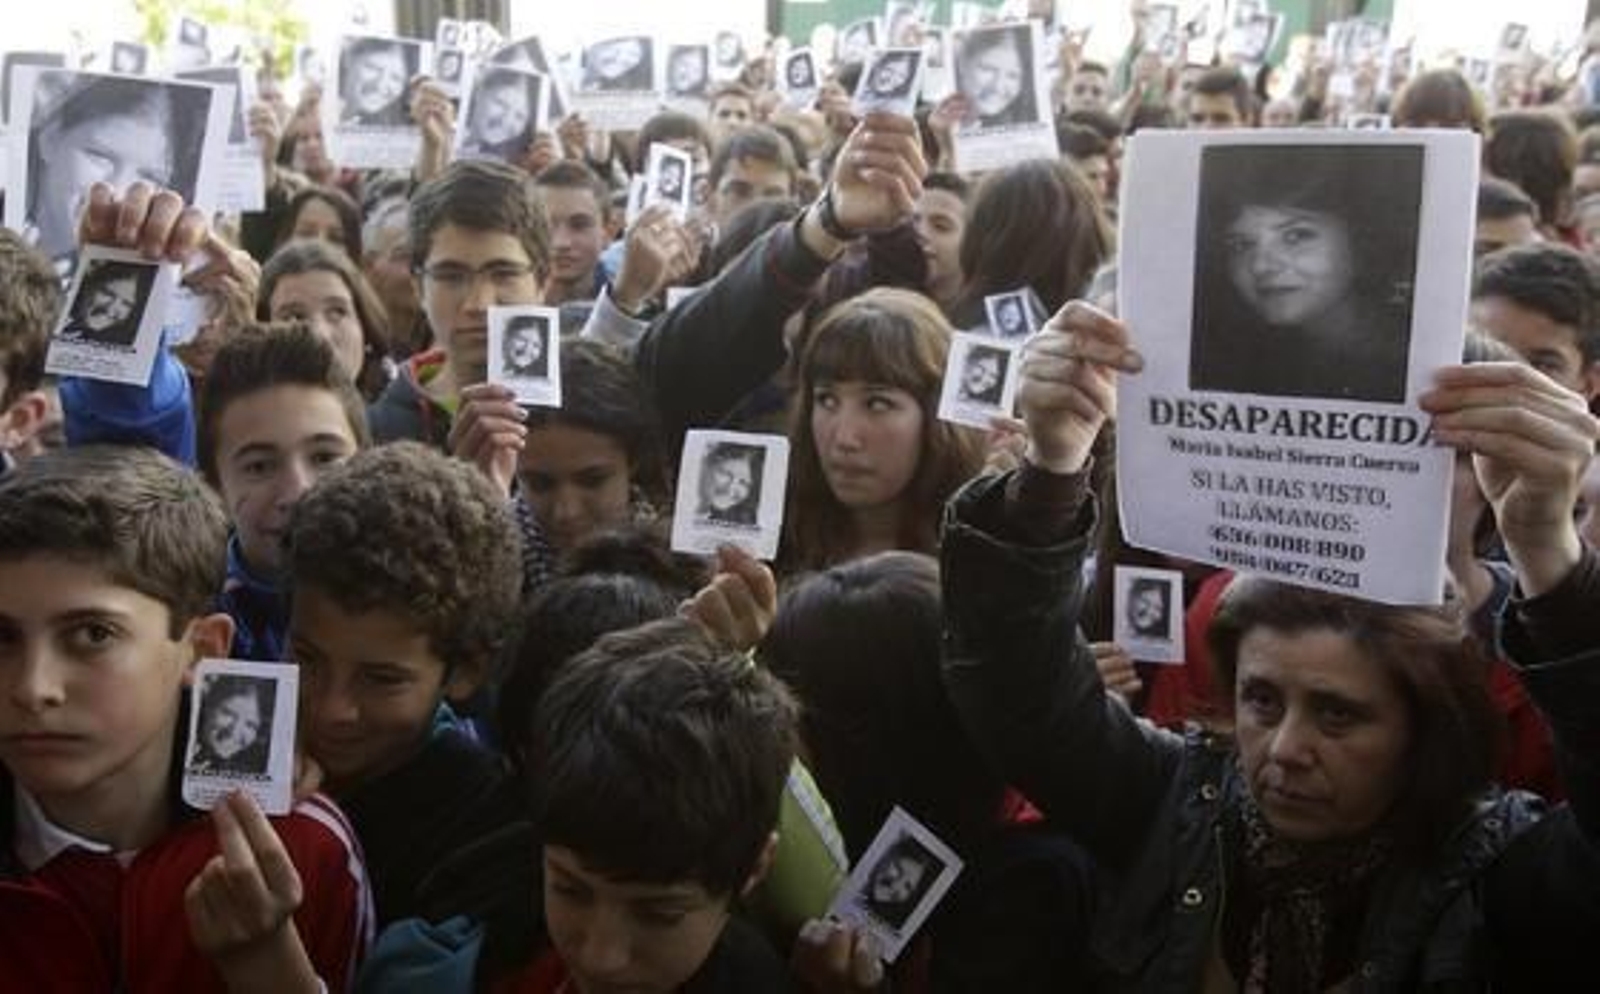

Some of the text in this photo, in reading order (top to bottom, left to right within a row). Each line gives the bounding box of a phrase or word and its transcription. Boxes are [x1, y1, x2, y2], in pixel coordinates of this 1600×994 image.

[1227, 444, 1283, 462] Isabel
[1287, 449, 1346, 468] Sierra
[1191, 470, 1392, 510] SI LA HAS VISTO,
